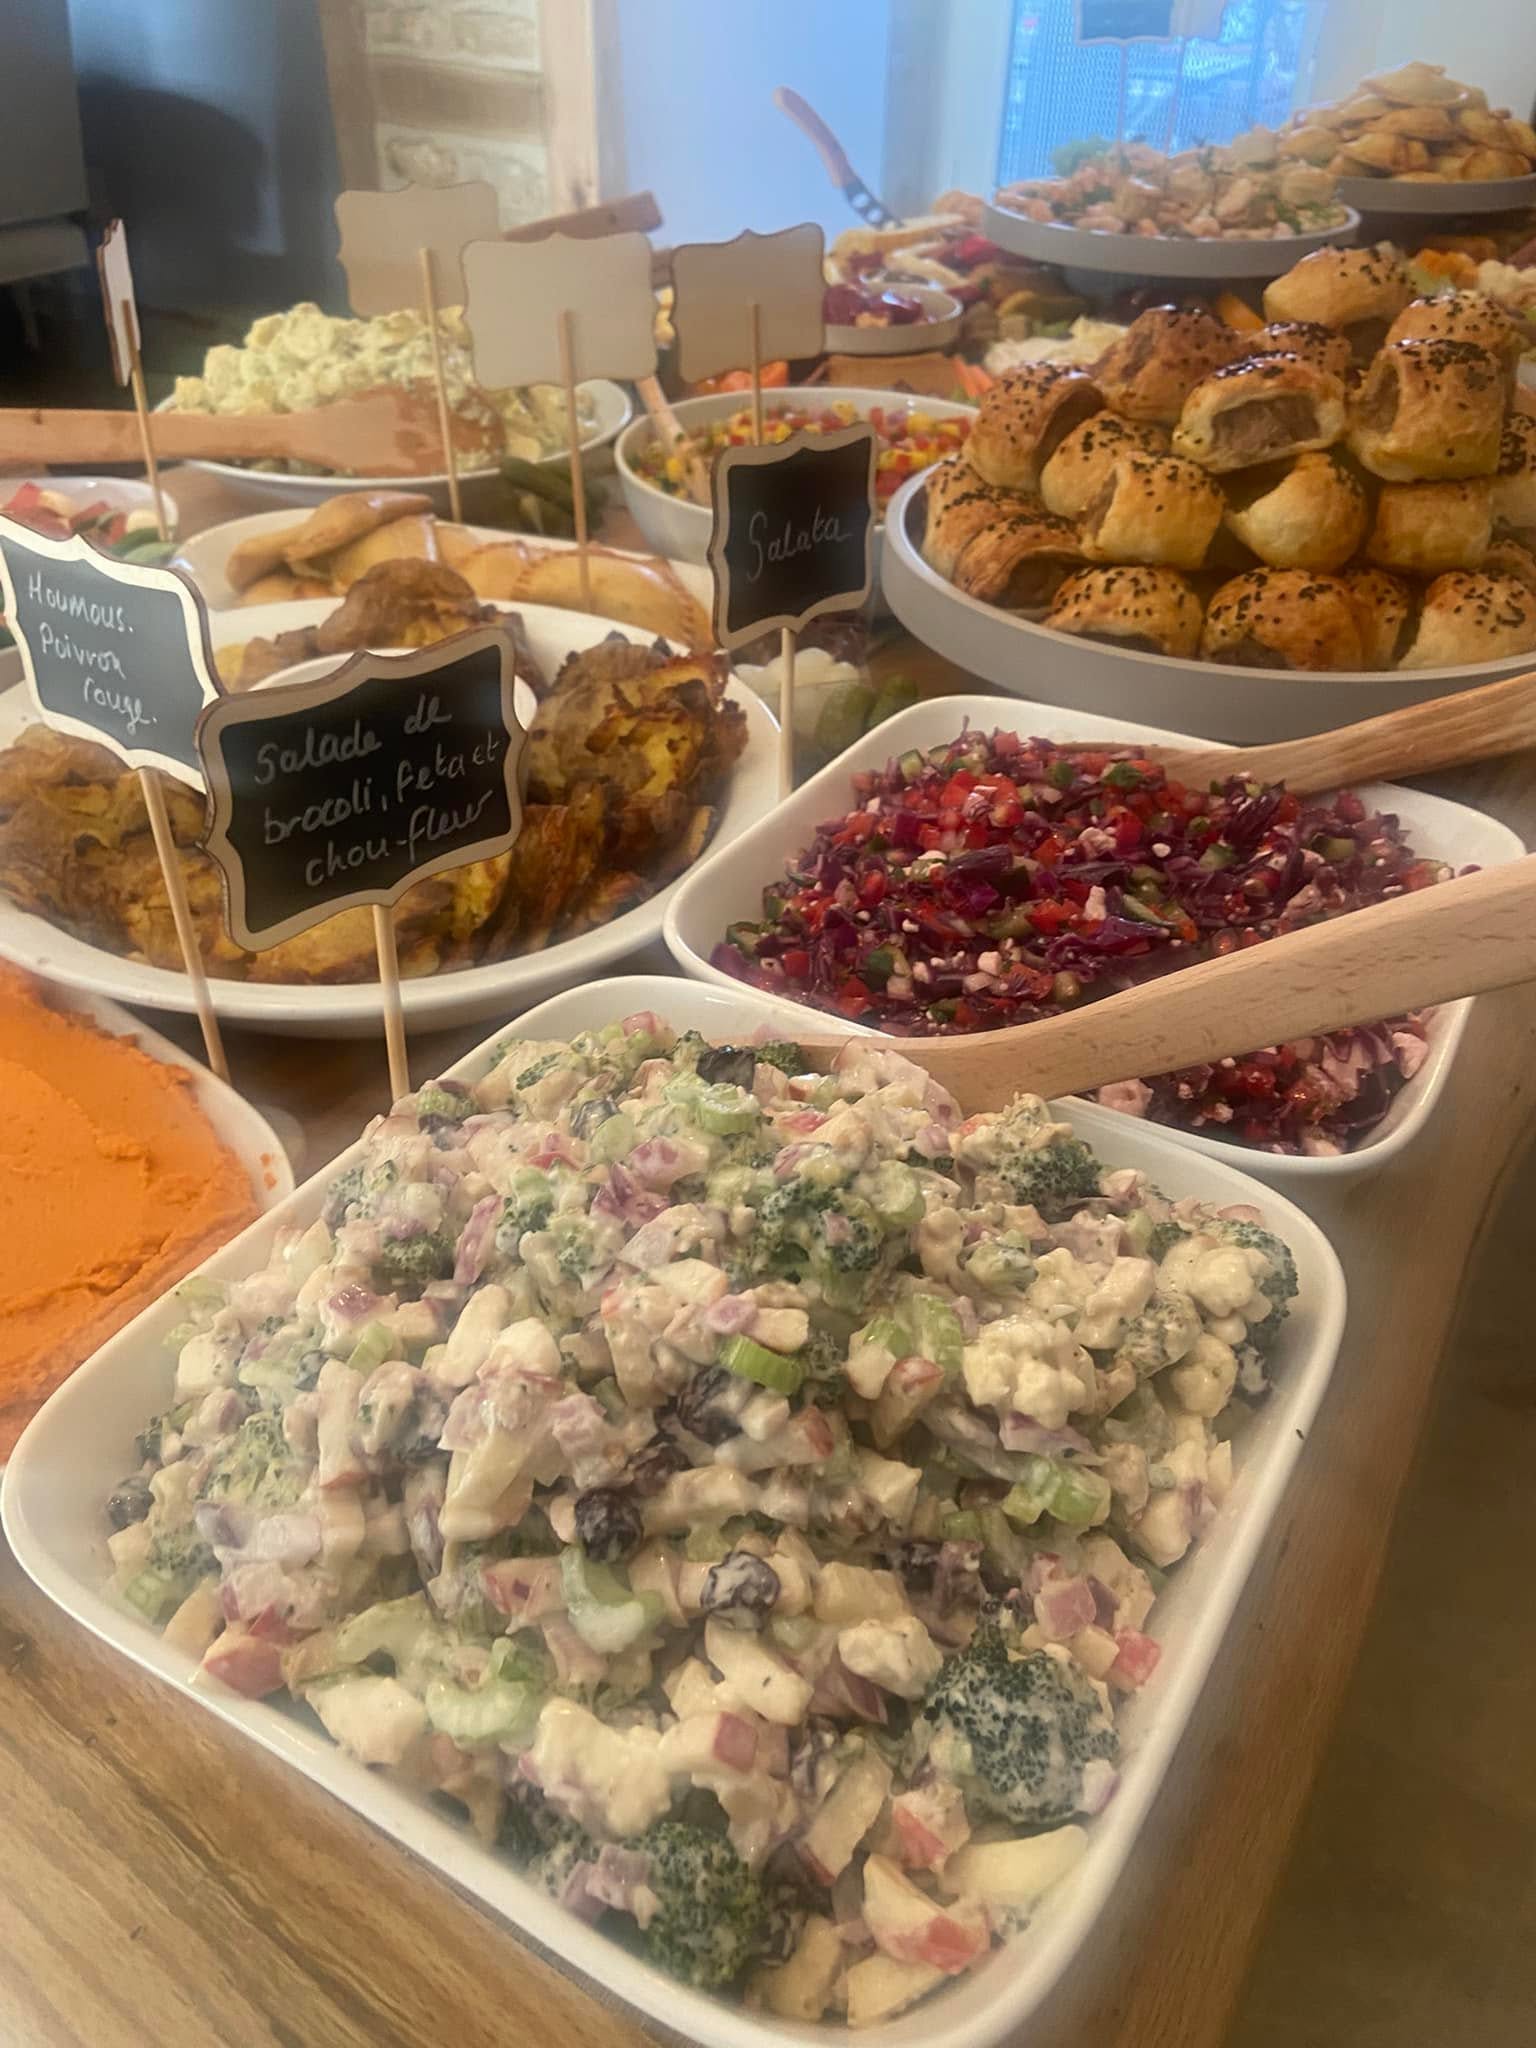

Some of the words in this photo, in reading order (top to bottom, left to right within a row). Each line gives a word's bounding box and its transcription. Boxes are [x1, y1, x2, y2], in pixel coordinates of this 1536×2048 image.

[747, 503, 853, 584] Salata
[39, 622, 127, 680] Poivron
[254, 720, 382, 785] Salade
[403, 693, 452, 735] de
[396, 744, 465, 802] feta
[472, 730, 502, 766] et
[305, 789, 494, 887] chou-fleur
